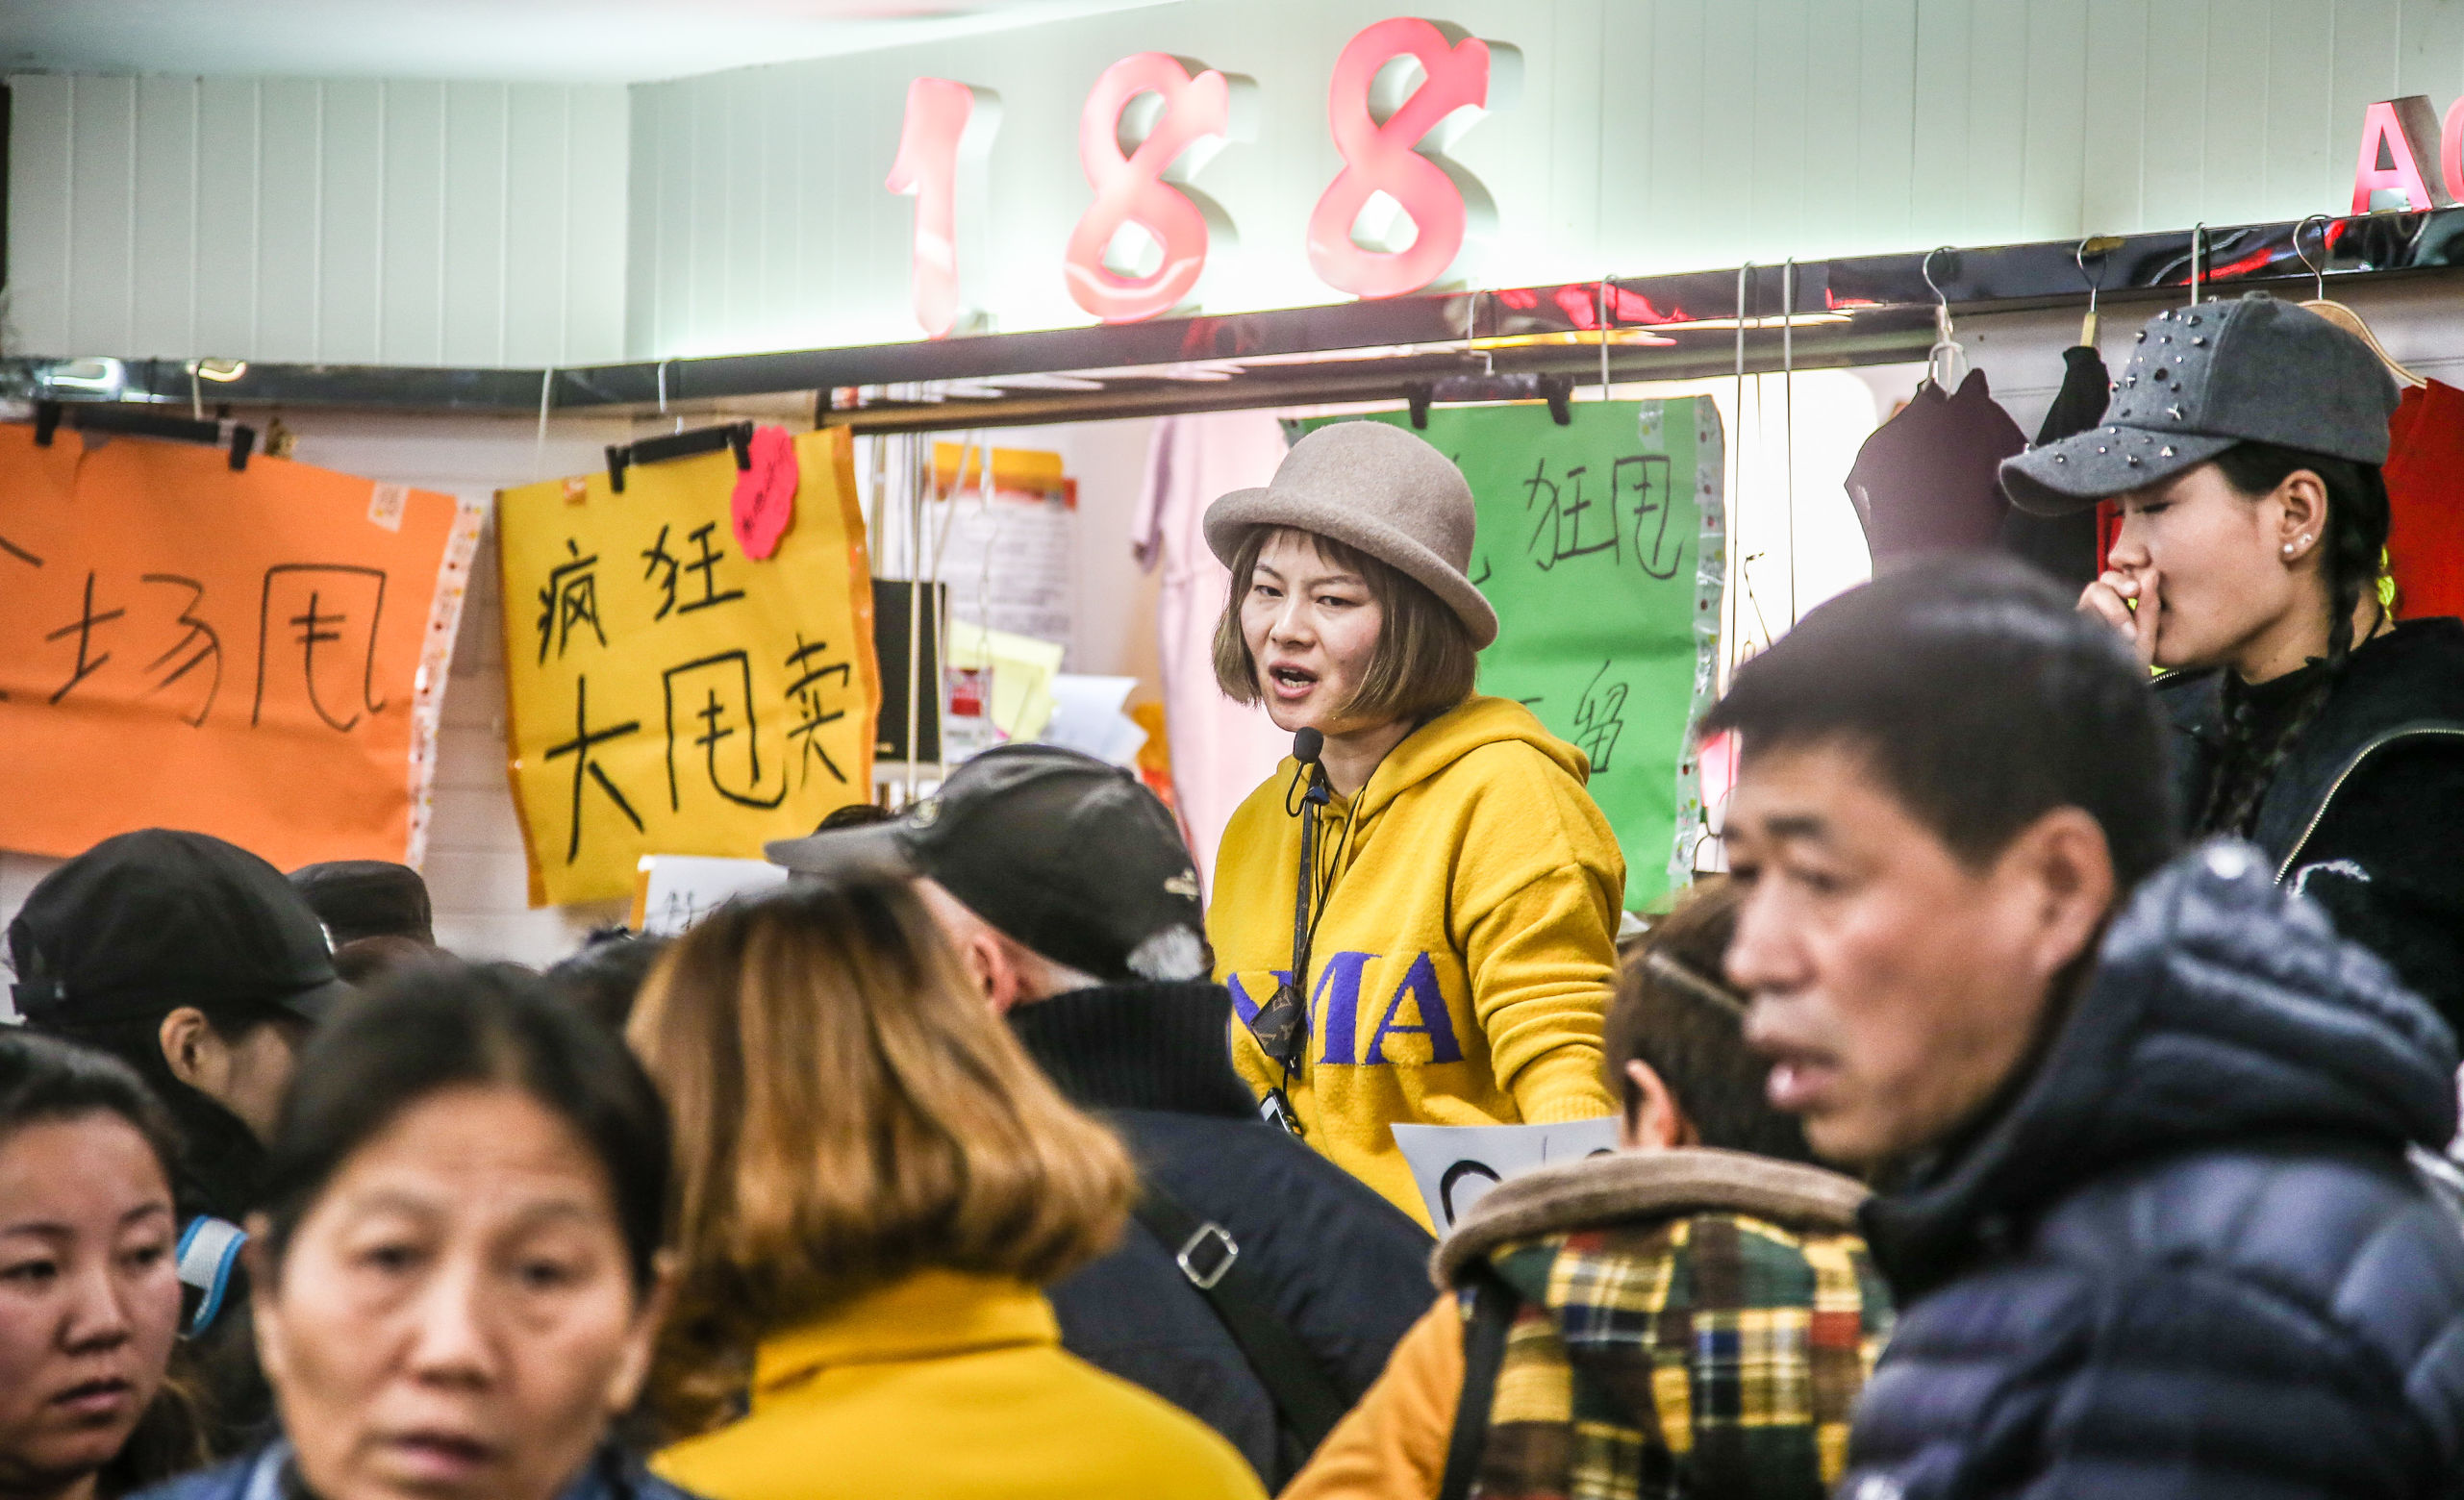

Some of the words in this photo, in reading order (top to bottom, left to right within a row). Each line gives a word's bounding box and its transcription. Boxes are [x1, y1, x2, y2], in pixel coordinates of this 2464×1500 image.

[885, 16, 1490, 339] 188
[537, 520, 745, 668] 疯狂
[1453, 452, 1683, 581] 狂甩
[0, 536, 387, 733] 场甩
[543, 632, 851, 865] 大甩卖
